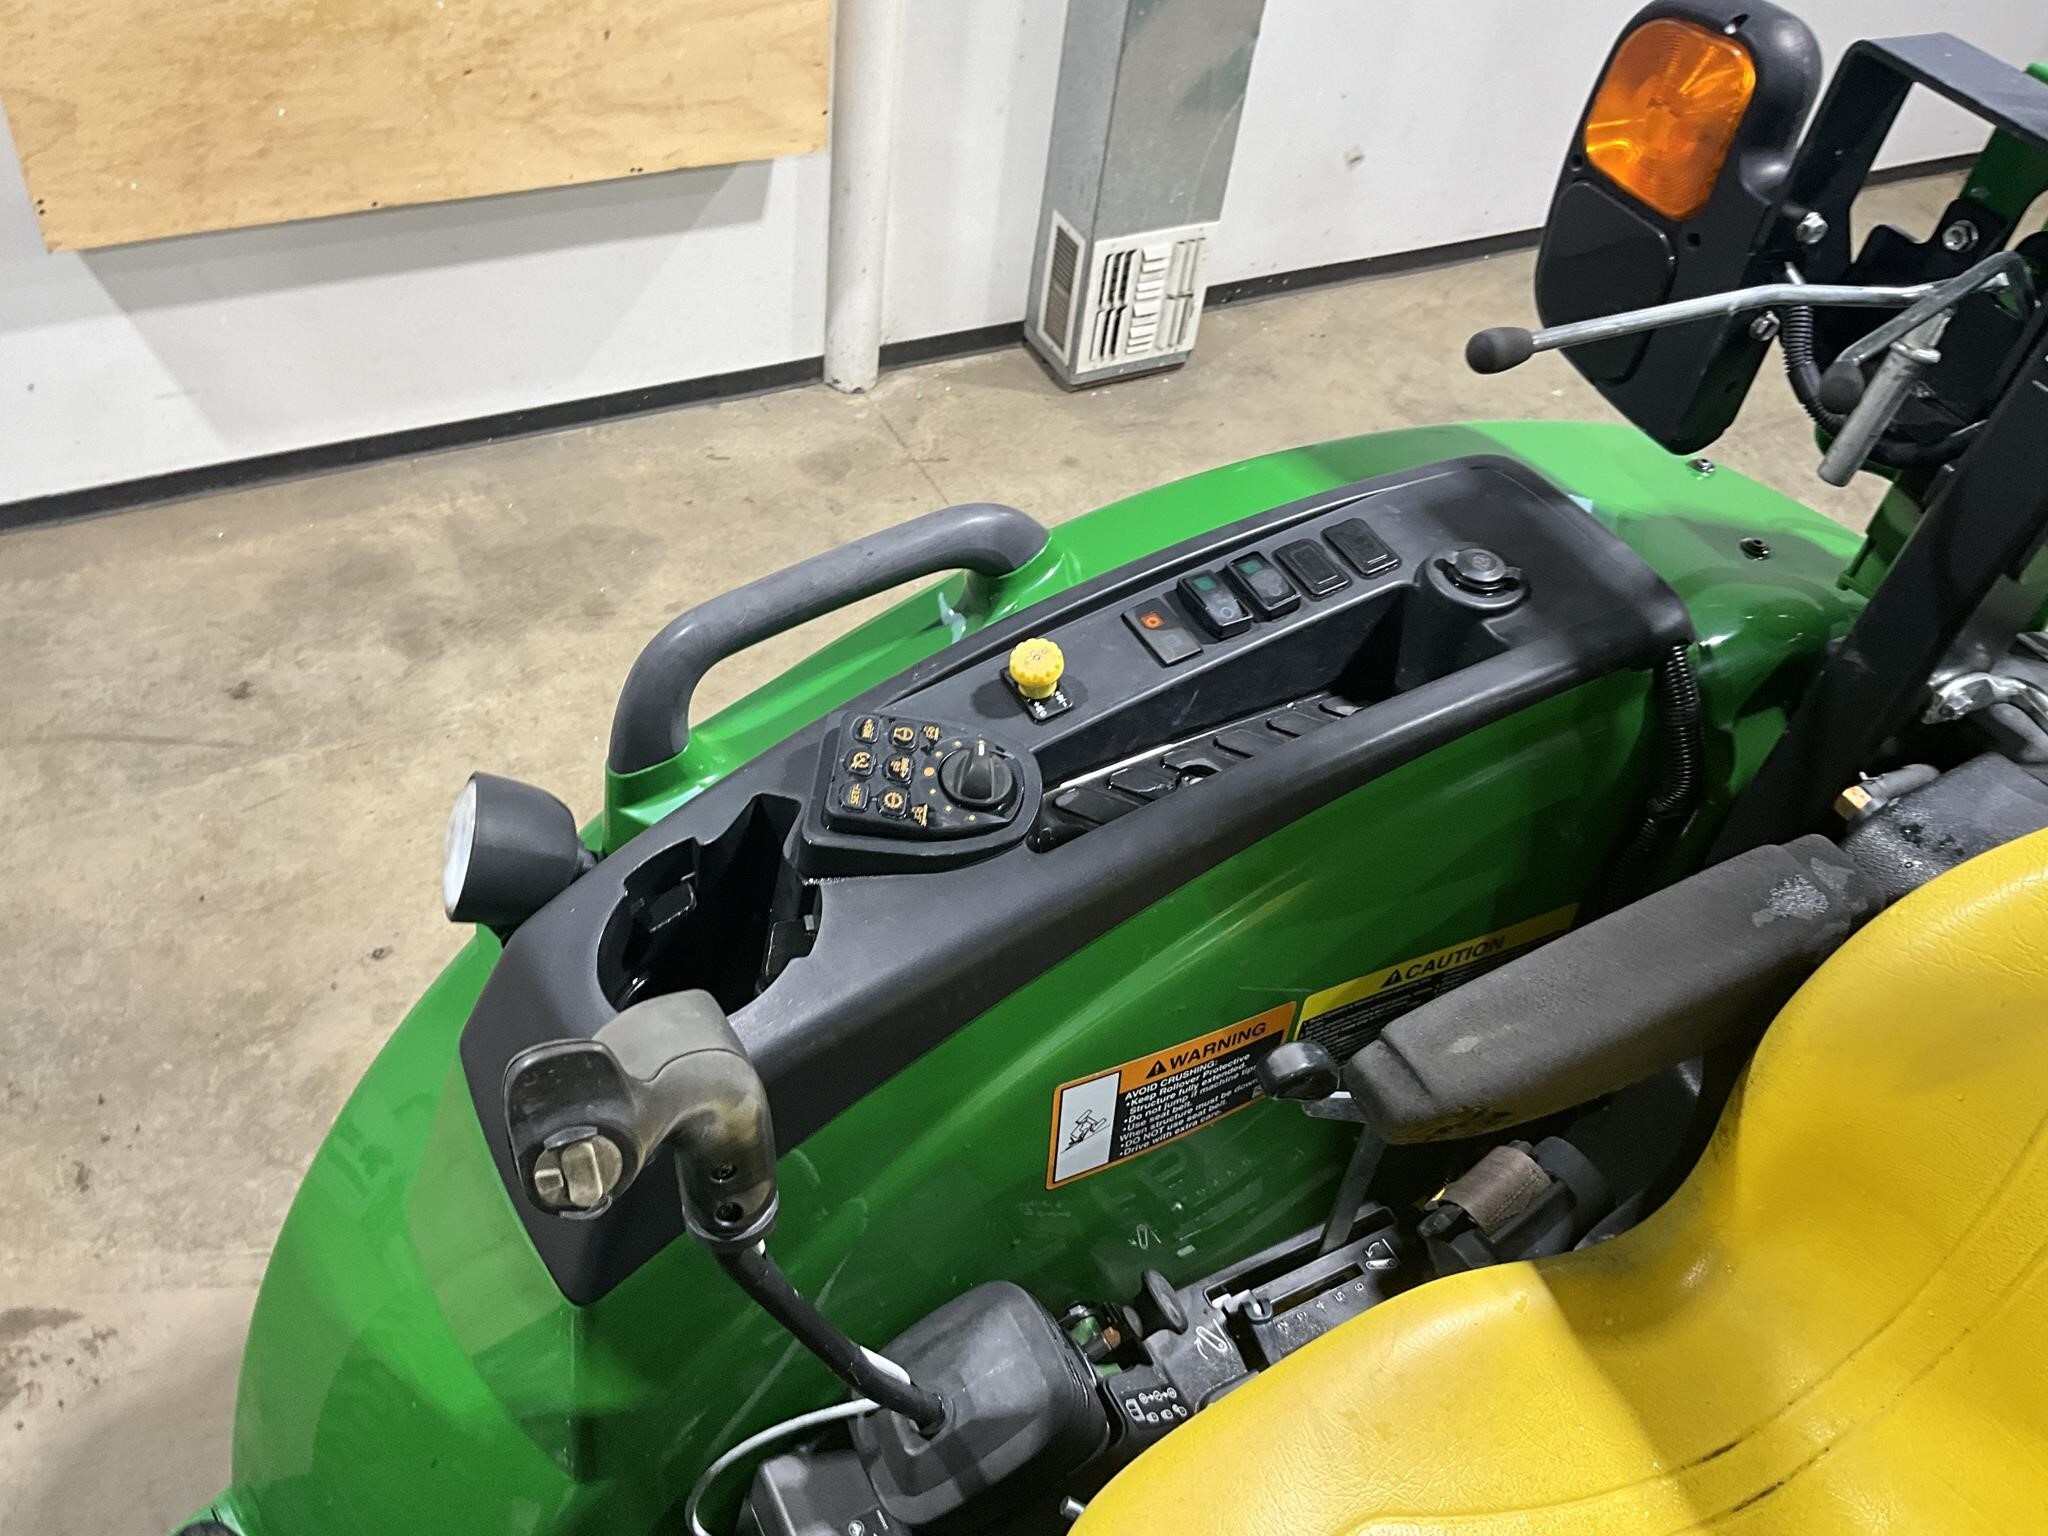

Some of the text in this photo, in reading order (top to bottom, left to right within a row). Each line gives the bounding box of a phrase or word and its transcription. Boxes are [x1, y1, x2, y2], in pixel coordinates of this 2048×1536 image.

[1404, 935, 1506, 981] CAUTION
[1169, 1022, 1267, 1070] WARNING
[1124, 1060, 1219, 1101] AVOID CRUSHING:
[1129, 1062, 1247, 1115] Structure fully extended.
[1145, 1104, 1162, 1117] not
[1163, 1094, 1188, 1113] jump
[1199, 1070, 1240, 1094] machine
[1159, 1075, 1201, 1096] Rollover
[1202, 1053, 1251, 1078] Protective
[1119, 1127, 1148, 1142] When
[1149, 1106, 1194, 1130] structure
[1195, 1096, 1219, 1111] must
[1220, 1089, 1232, 1100] be
[1143, 1126, 1166, 1141] NOT
[1166, 1118, 1185, 1131] use
[1186, 1107, 1207, 1120] seat
[1149, 1111, 1170, 1125] seat
[1151, 1130, 1173, 1144] with
[1174, 1120, 1198, 1137] extra
